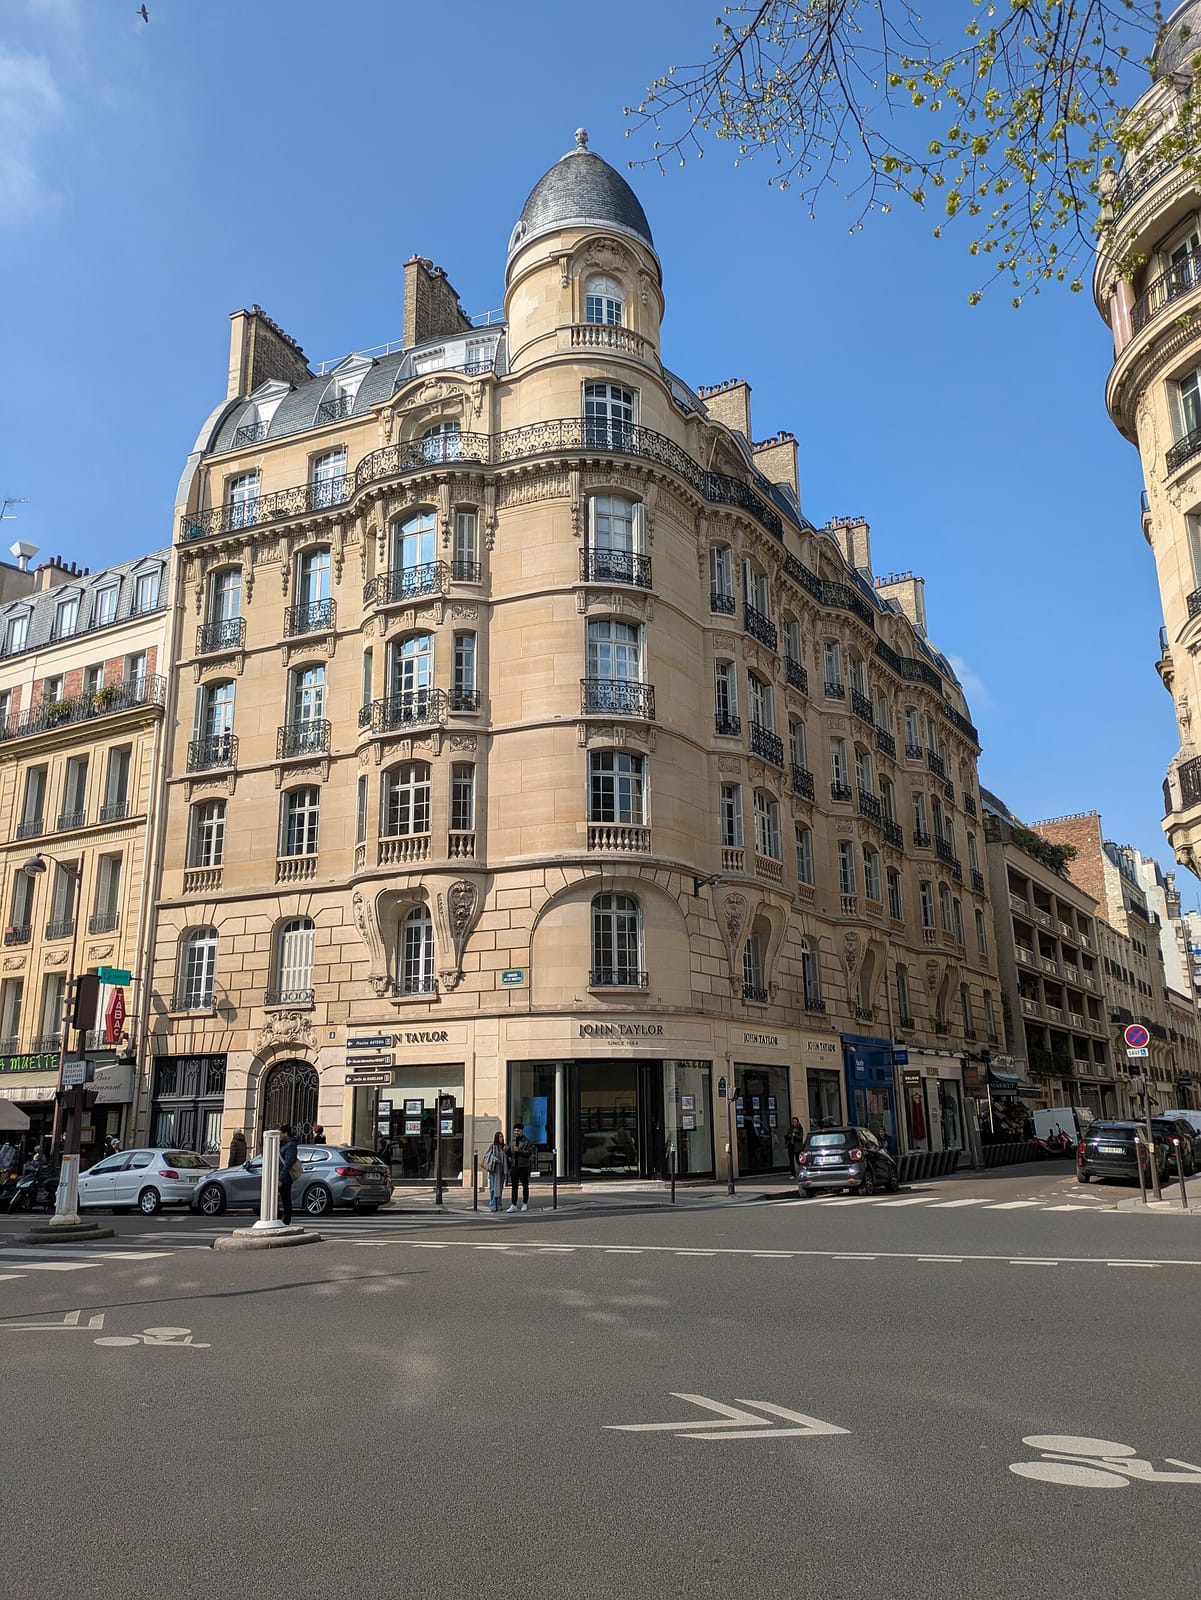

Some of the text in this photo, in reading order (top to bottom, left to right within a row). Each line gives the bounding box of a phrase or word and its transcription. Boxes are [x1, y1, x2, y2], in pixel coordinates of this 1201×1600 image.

[114, 993, 122, 1036] TABAC
[579, 1024, 664, 1037] JOHN TAYLOR
[405, 1031, 448, 1044] TAYLOR
[743, 1032, 778, 1046] JOHN TAYLOR
[807, 1041, 836, 1052] JOHN TAYLOR
[11, 1054, 58, 1070] MUETTE
[95, 1072, 111, 1081] Bar
